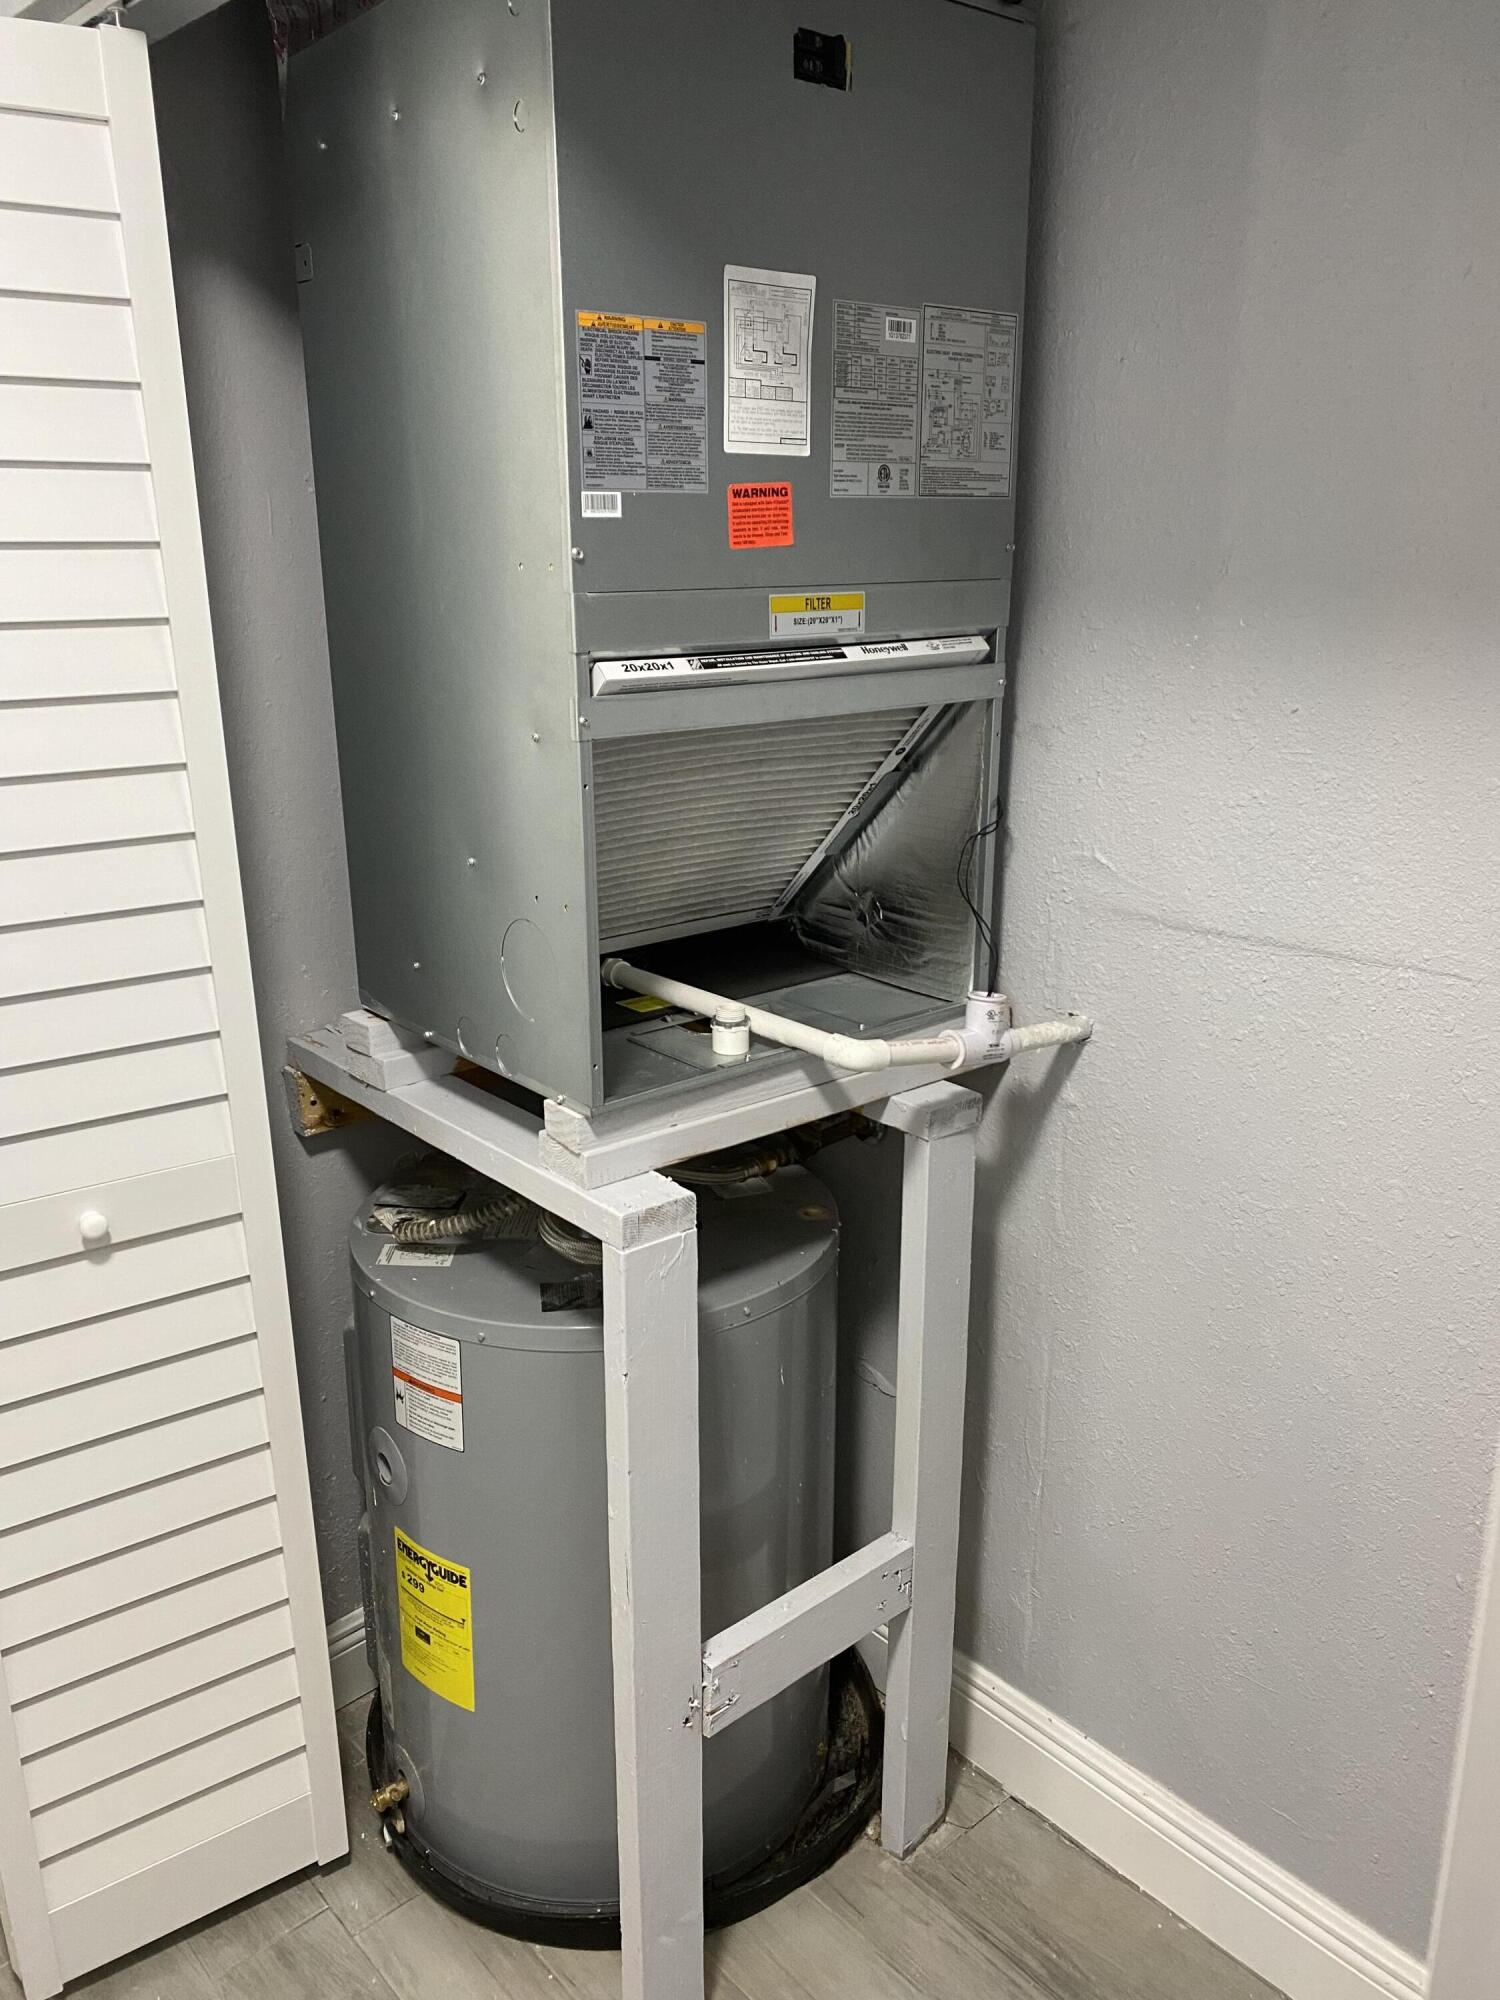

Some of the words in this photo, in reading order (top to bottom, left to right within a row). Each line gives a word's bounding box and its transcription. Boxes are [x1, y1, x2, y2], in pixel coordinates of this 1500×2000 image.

[732, 487, 789, 498] WARNING
[805, 597, 831, 611] FILTER
[860, 643, 908, 655] Honeywell
[621, 661, 674, 673] 20x20x1
[407, 1573, 424, 1594] 299
